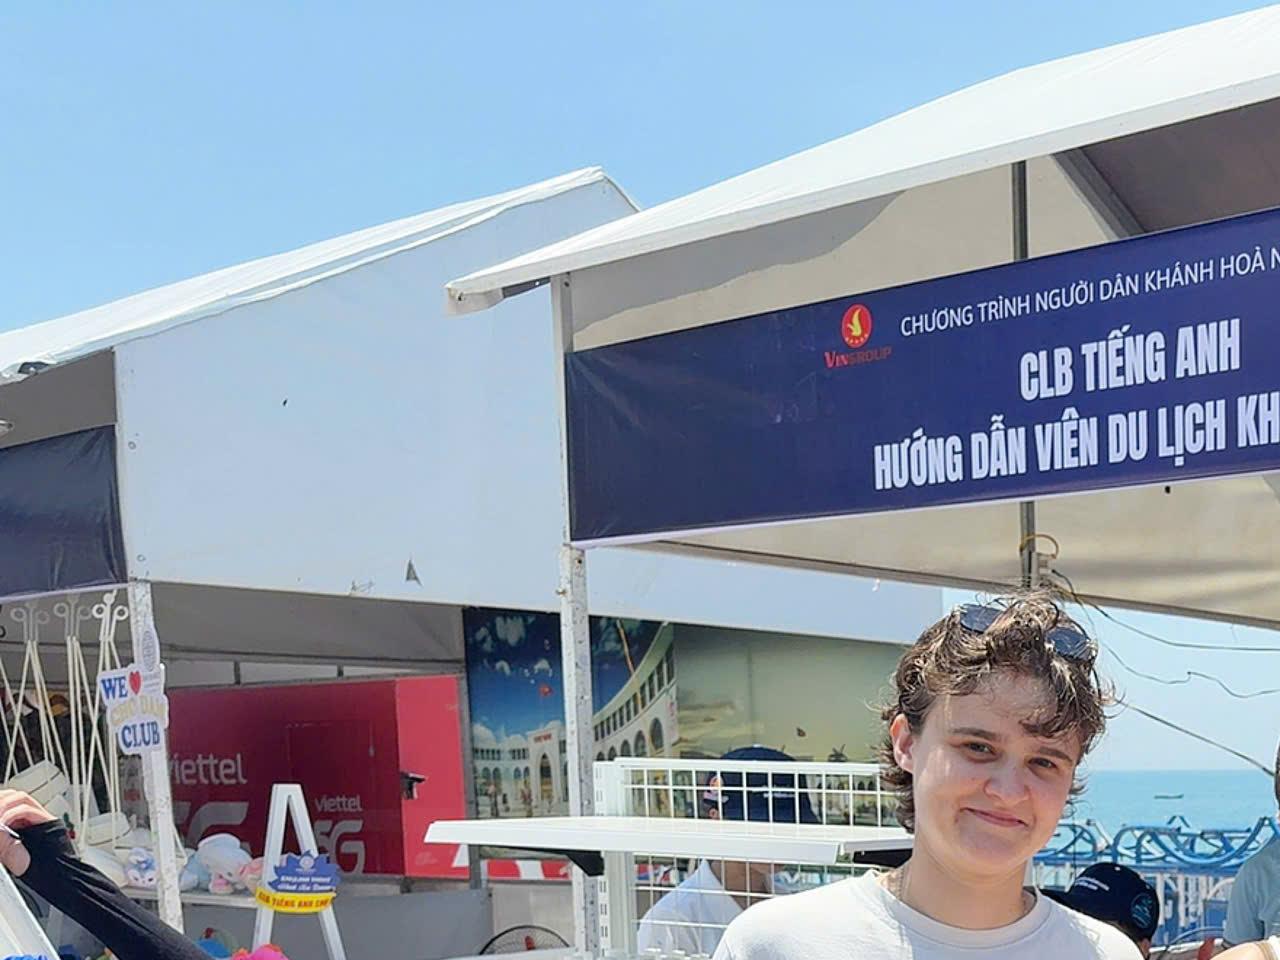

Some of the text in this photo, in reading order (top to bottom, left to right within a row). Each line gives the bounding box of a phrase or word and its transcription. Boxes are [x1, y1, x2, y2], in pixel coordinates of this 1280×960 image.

[901, 304, 974, 337] CHƯƠNG
[978, 294, 1031, 324] TRÌNH
[1035, 280, 1094, 312] NGƯỜI
[1099, 273, 1139, 301] DÂN
[1145, 259, 1214, 293] KHÁNH
[1220, 246, 1266, 279] HOÀ
[1020, 318, 1241, 401] CLB TIẾNG ANH
[874, 427, 963, 490] HƯỚNG
[970, 414, 1027, 481] DẪN
[1034, 406, 1099, 472] VIÊN
[1108, 409, 1148, 464] DU
[1158, 398, 1227, 467] LỊCH
[100, 676, 128, 699] WE
[121, 720, 160, 748] CLUB
